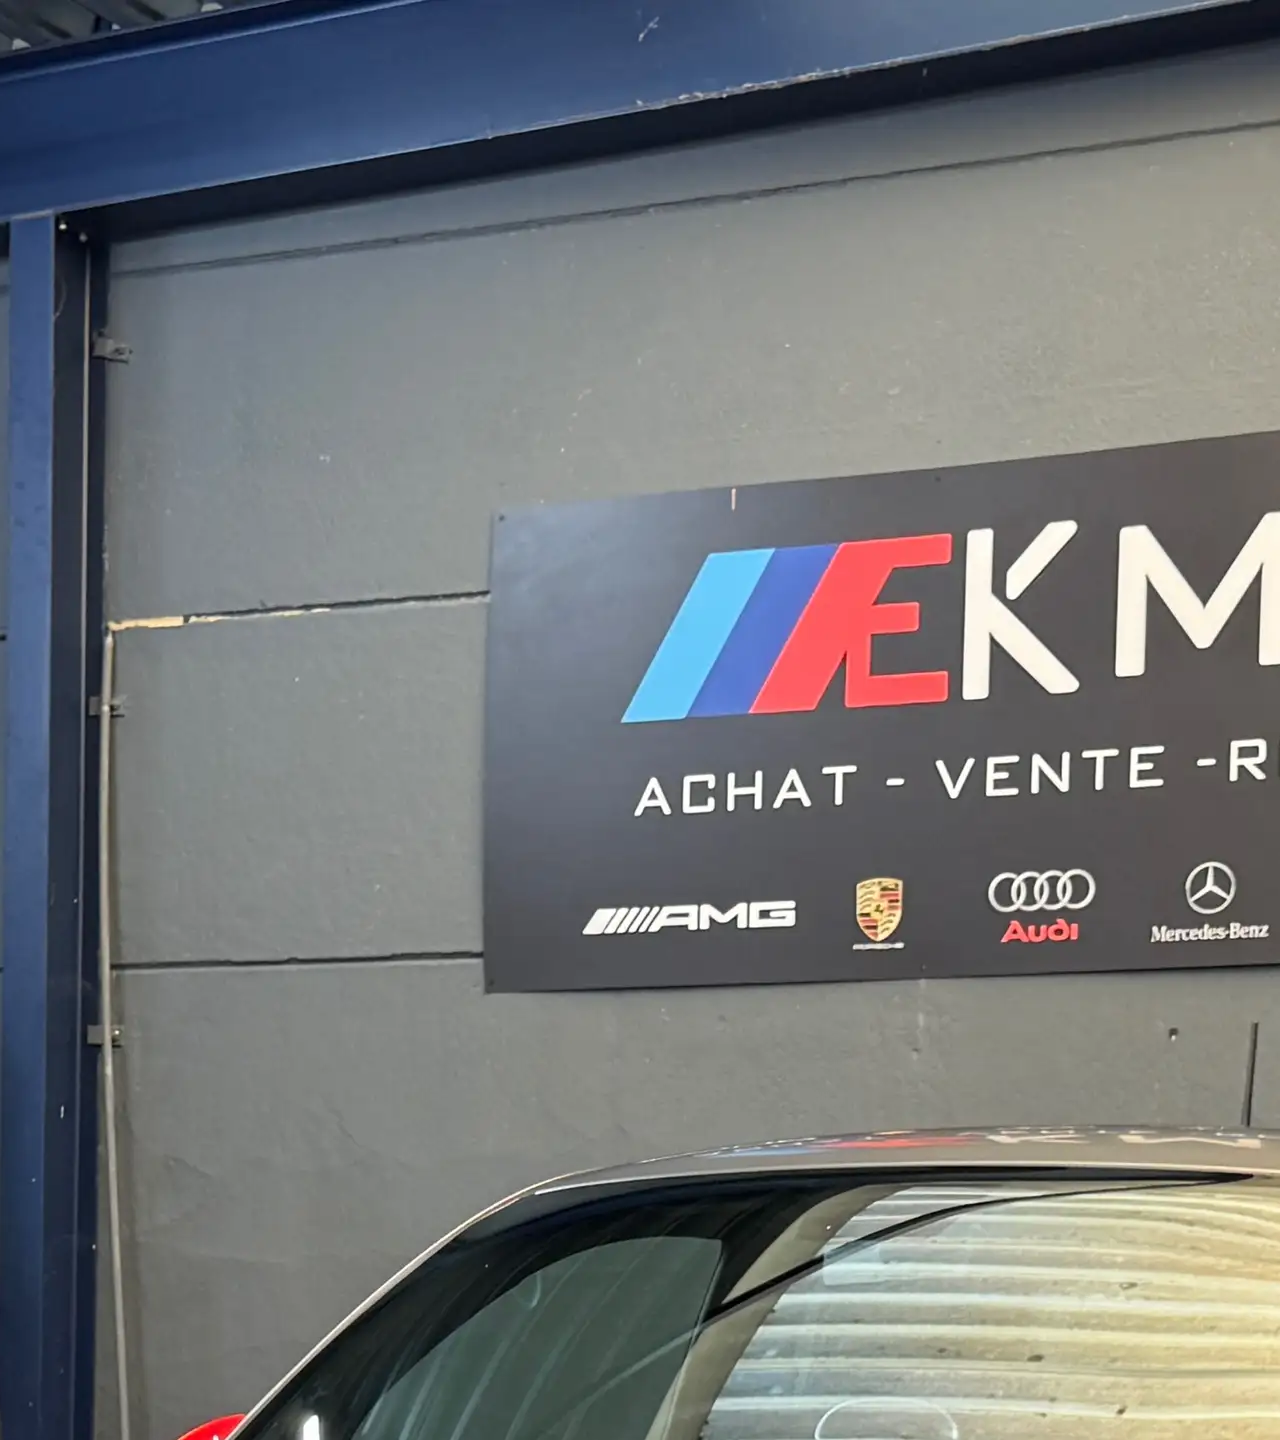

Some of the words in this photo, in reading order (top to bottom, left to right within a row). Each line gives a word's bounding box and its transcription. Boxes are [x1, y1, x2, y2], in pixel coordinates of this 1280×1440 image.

[634, 765, 857, 816] ACHAT
[935, 745, 1165, 799] VENTE
[653, 900, 796, 932] AMG
[1001, 919, 1078, 943] Audi
[1151, 922, 1269, 942] Mercedes-Benz
